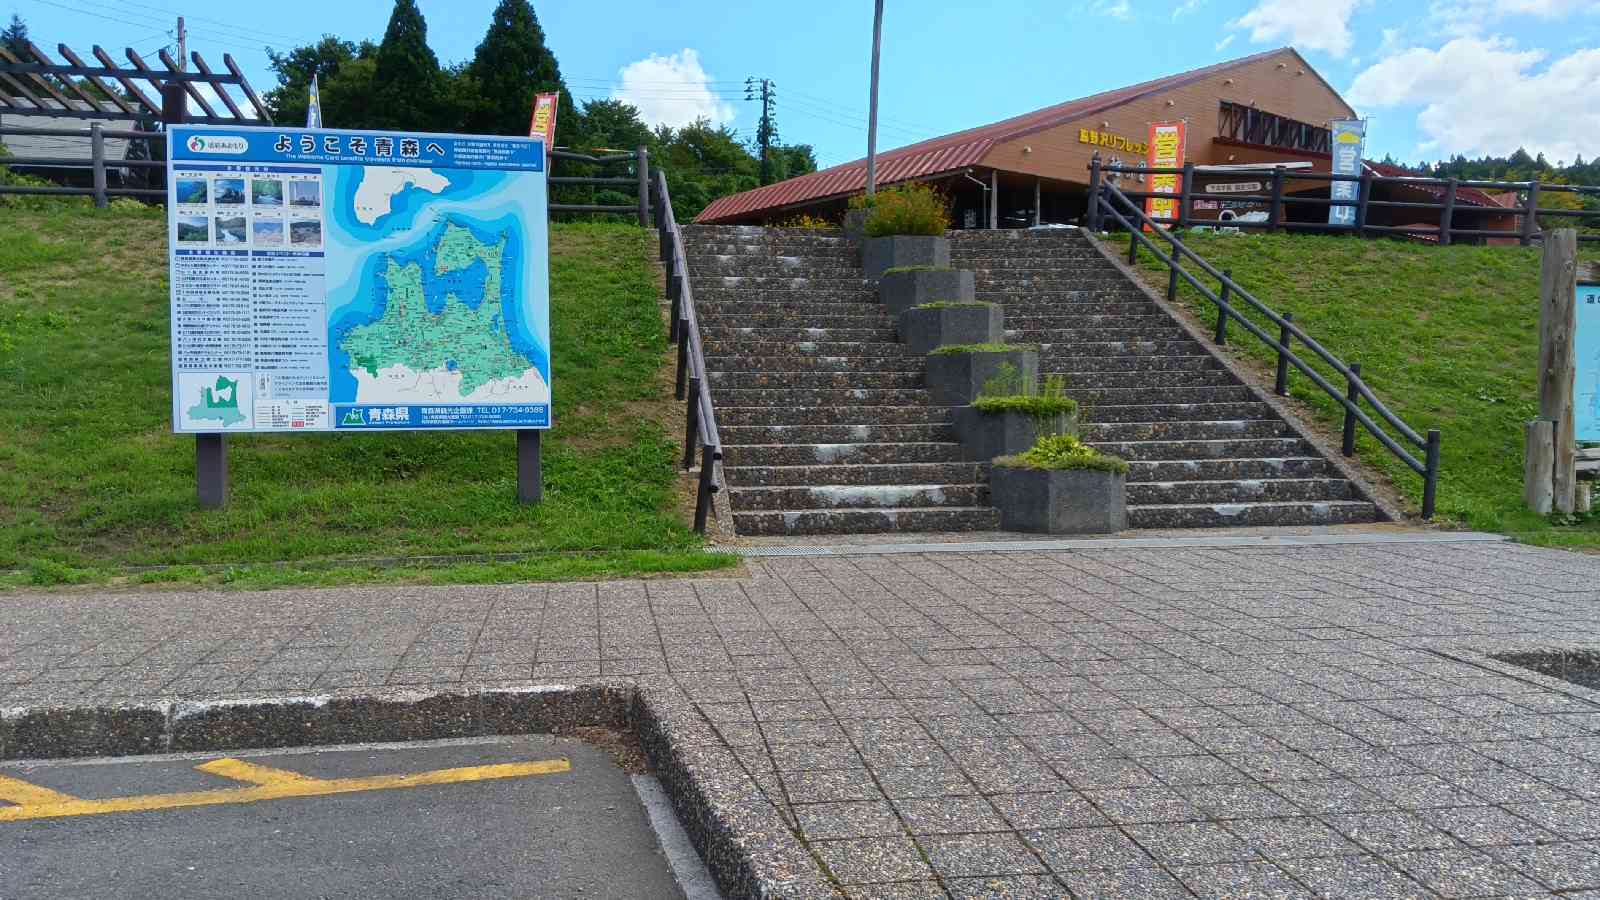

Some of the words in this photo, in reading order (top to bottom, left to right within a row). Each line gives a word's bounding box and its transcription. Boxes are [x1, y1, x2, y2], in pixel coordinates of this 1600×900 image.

[274, 134, 445, 157] ようこそ青森へ
[1585, 294, 1600, 305] 道
[368, 406, 409, 421] 青森県
